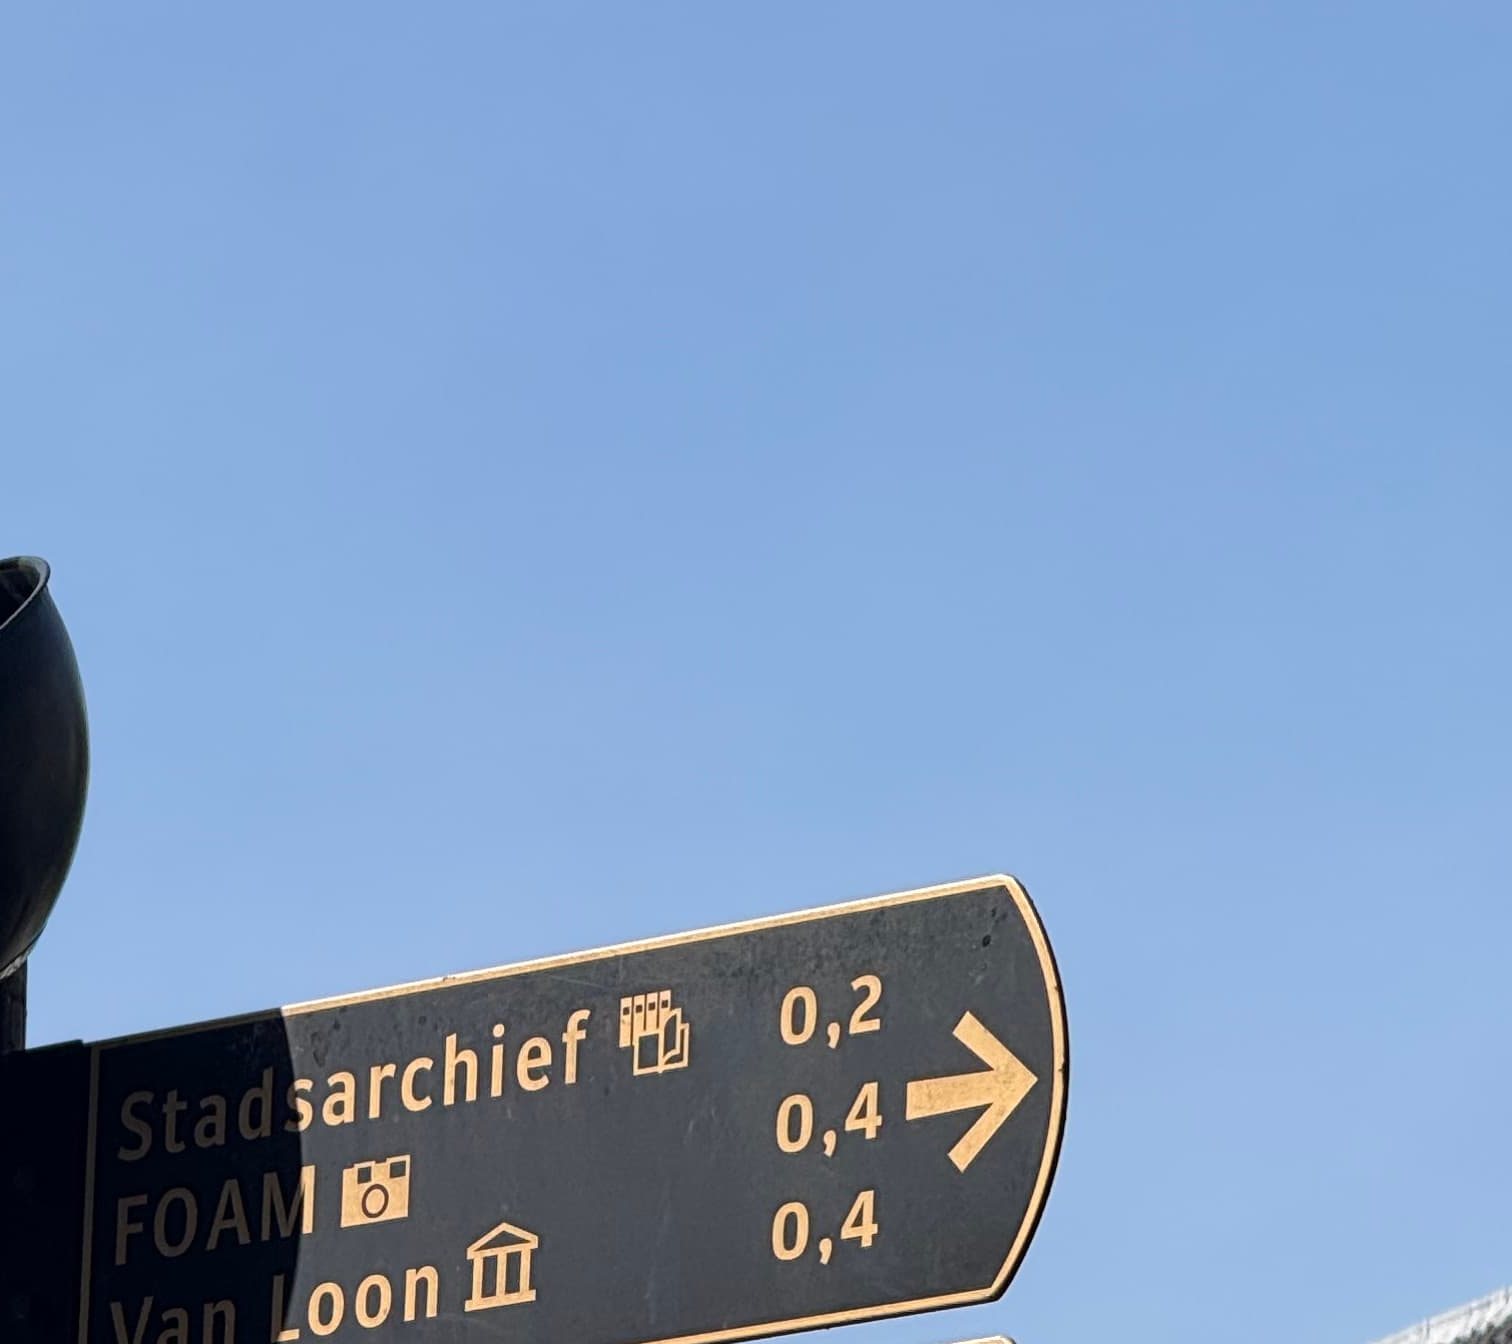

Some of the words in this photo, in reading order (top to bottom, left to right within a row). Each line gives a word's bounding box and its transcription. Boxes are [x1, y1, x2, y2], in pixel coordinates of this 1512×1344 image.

[116, 1007, 591, 1162] Stadsarchief
[779, 974, 883, 1049] 0,2
[114, 1164, 317, 1266] FOAM
[775, 1081, 883, 1158] 0,4
[270, 1260, 439, 1343] Loon
[771, 1189, 880, 1265] 0,4
